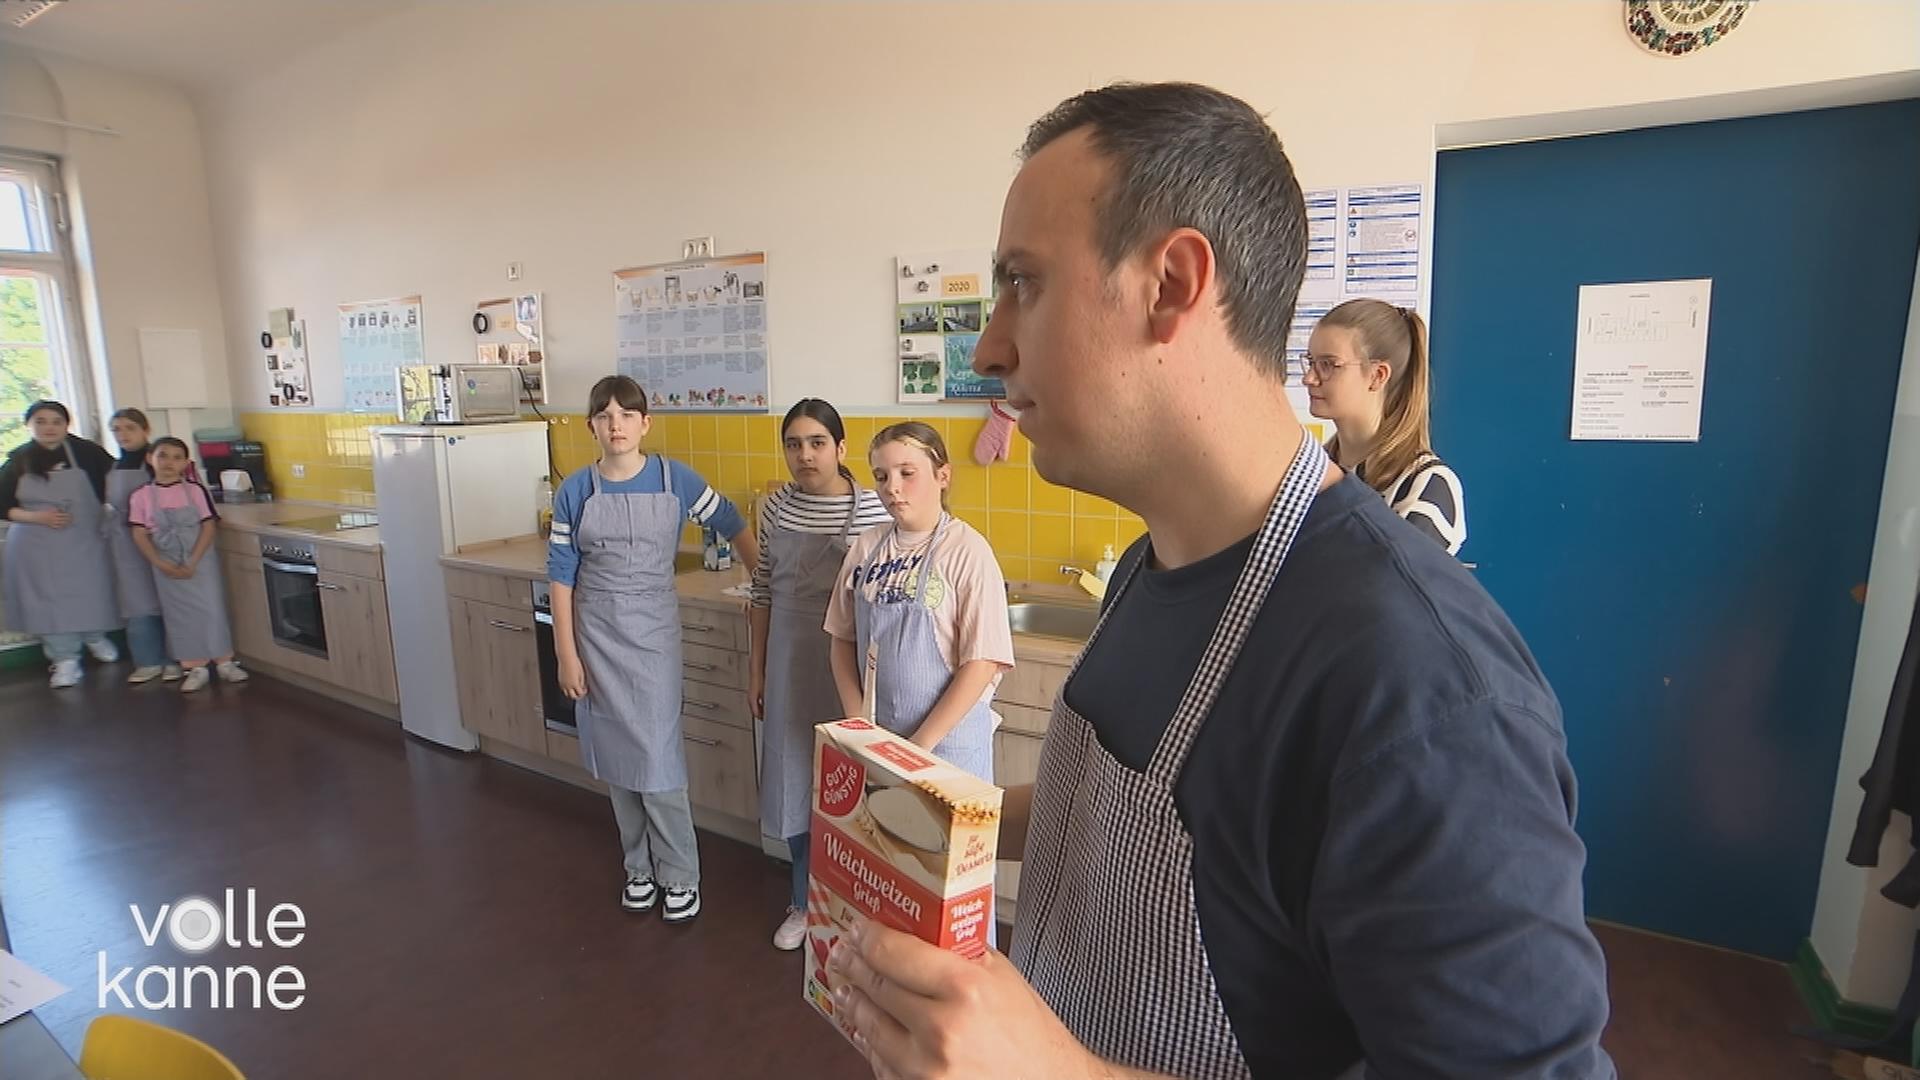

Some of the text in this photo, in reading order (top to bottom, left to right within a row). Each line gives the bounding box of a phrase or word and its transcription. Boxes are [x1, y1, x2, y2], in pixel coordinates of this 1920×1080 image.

[948, 281, 970, 292] 2020
[853, 555, 922, 588] FESHLY
[824, 833, 921, 922] Weichweizen
[853, 881, 880, 914] Grieß
